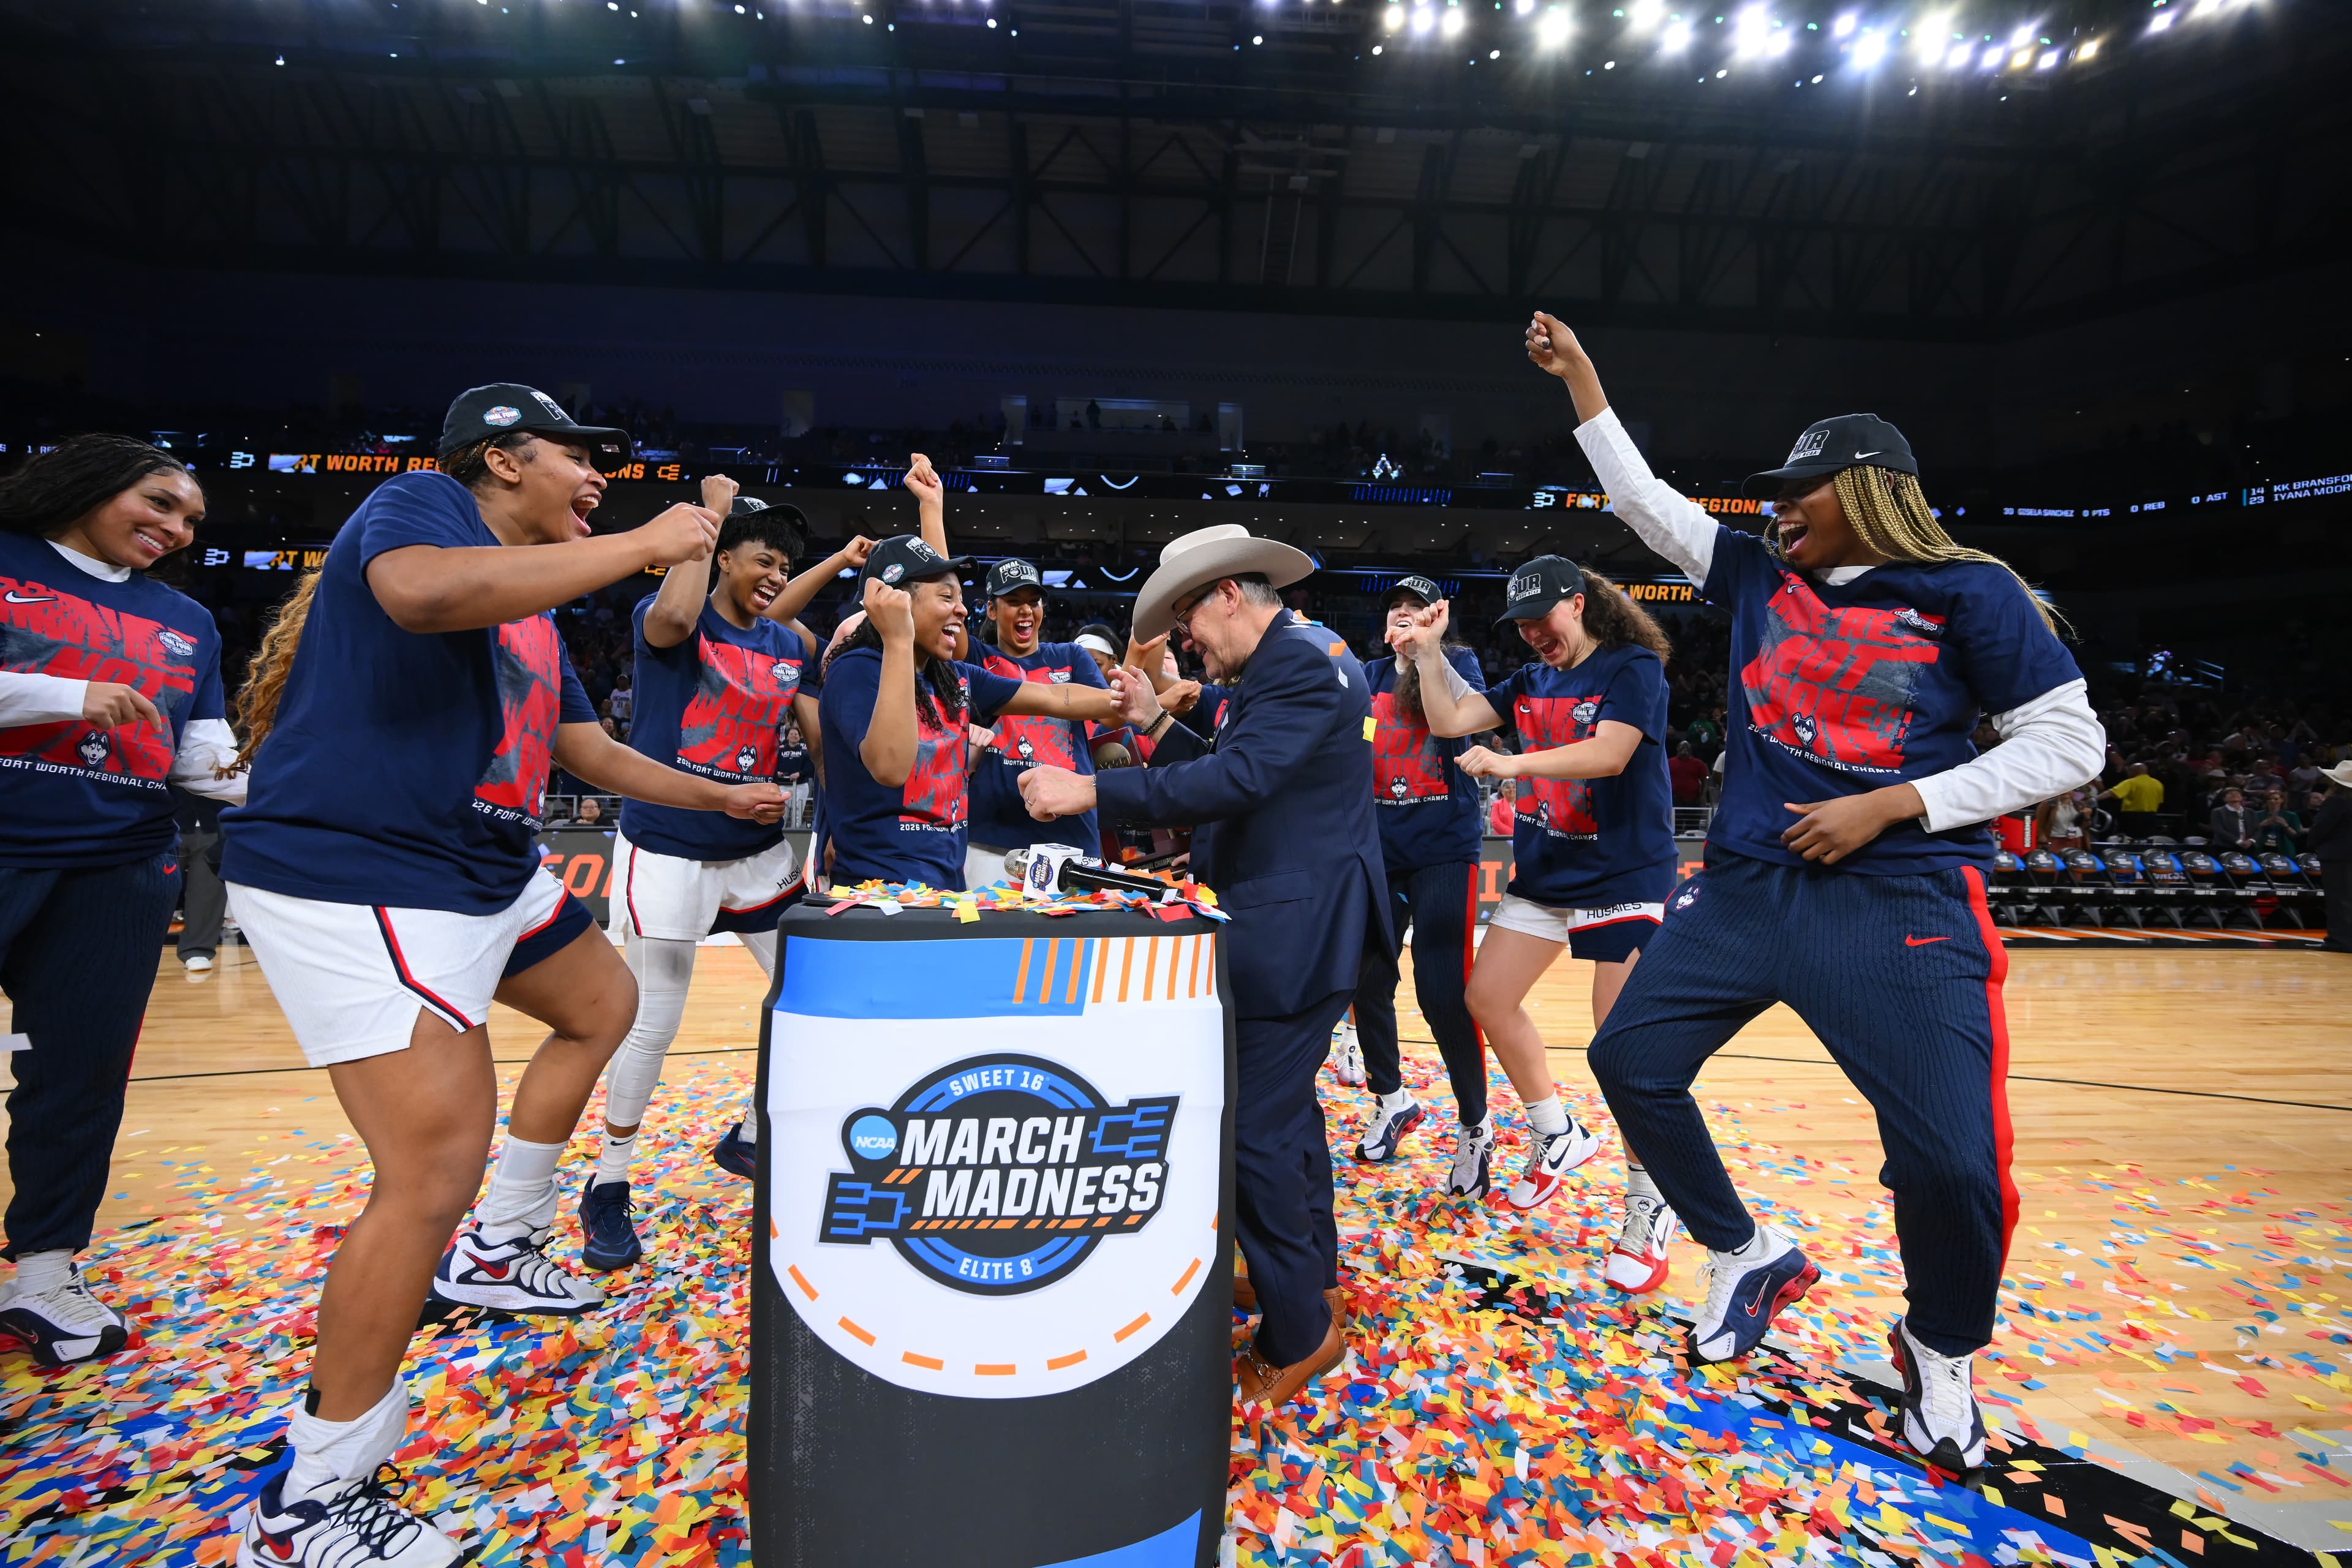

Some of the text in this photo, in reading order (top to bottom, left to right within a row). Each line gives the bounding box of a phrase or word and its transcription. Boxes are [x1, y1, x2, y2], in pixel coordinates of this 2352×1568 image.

[327, 454, 398, 472] WORTH
[407, 458, 440, 472] RE
[2250, 487, 2265, 496] 14
[2273, 483, 2290, 492] KK
[2273, 483, 2352, 502] IYANA MOOR
[2144, 501, 2165, 511] REB
[2206, 492, 2228, 502] AST
[2249, 496, 2265, 505] 23
[998, 560, 1020, 573] FINAL
[1000, 565, 1036, 583] FOUR
[1629, 584, 1692, 601] WORTH
[1804, 752, 1849, 771] REGIONAL
[36, 763, 85, 777] WORTH
[86, 771, 143, 787] REGIONAL
[692, 764, 712, 775] FORT
[714, 770, 741, 780] WORTH
[494, 808, 522, 821] FORT
[1519, 814, 1536, 824] FORT
[1587, 903, 1642, 919] HUSKIES
[949, 1069, 1044, 1097] SWEET 16
[855, 1136, 896, 1149] NCAA
[900, 1115, 1086, 1166] MARCH
[922, 1163, 1163, 1217] MADNESS
[959, 1257, 1033, 1280] ELITE 8
